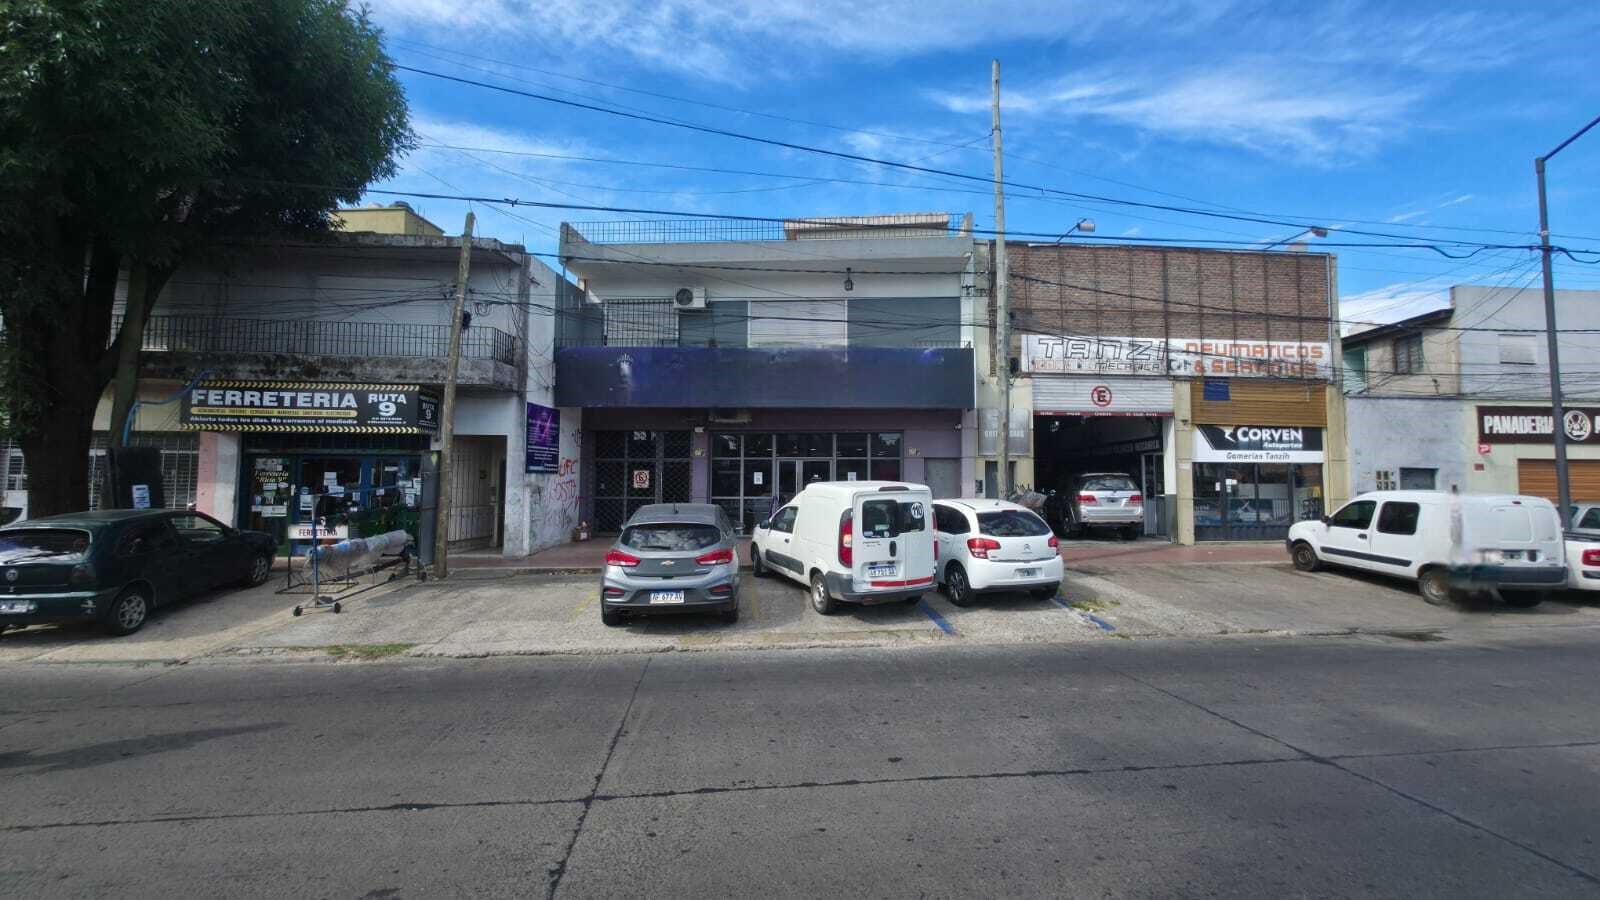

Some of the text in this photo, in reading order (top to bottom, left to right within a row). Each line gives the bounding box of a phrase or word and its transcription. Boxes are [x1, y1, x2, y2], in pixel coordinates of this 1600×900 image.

[1185, 342, 1324, 359] NEUMATICOS
[191, 389, 358, 408] FERRETERIA
[367, 393, 407, 404] RUTA
[1096, 389, 1107, 402] E
[378, 401, 397, 417] 9
[1236, 427, 1303, 442] CORVEN
